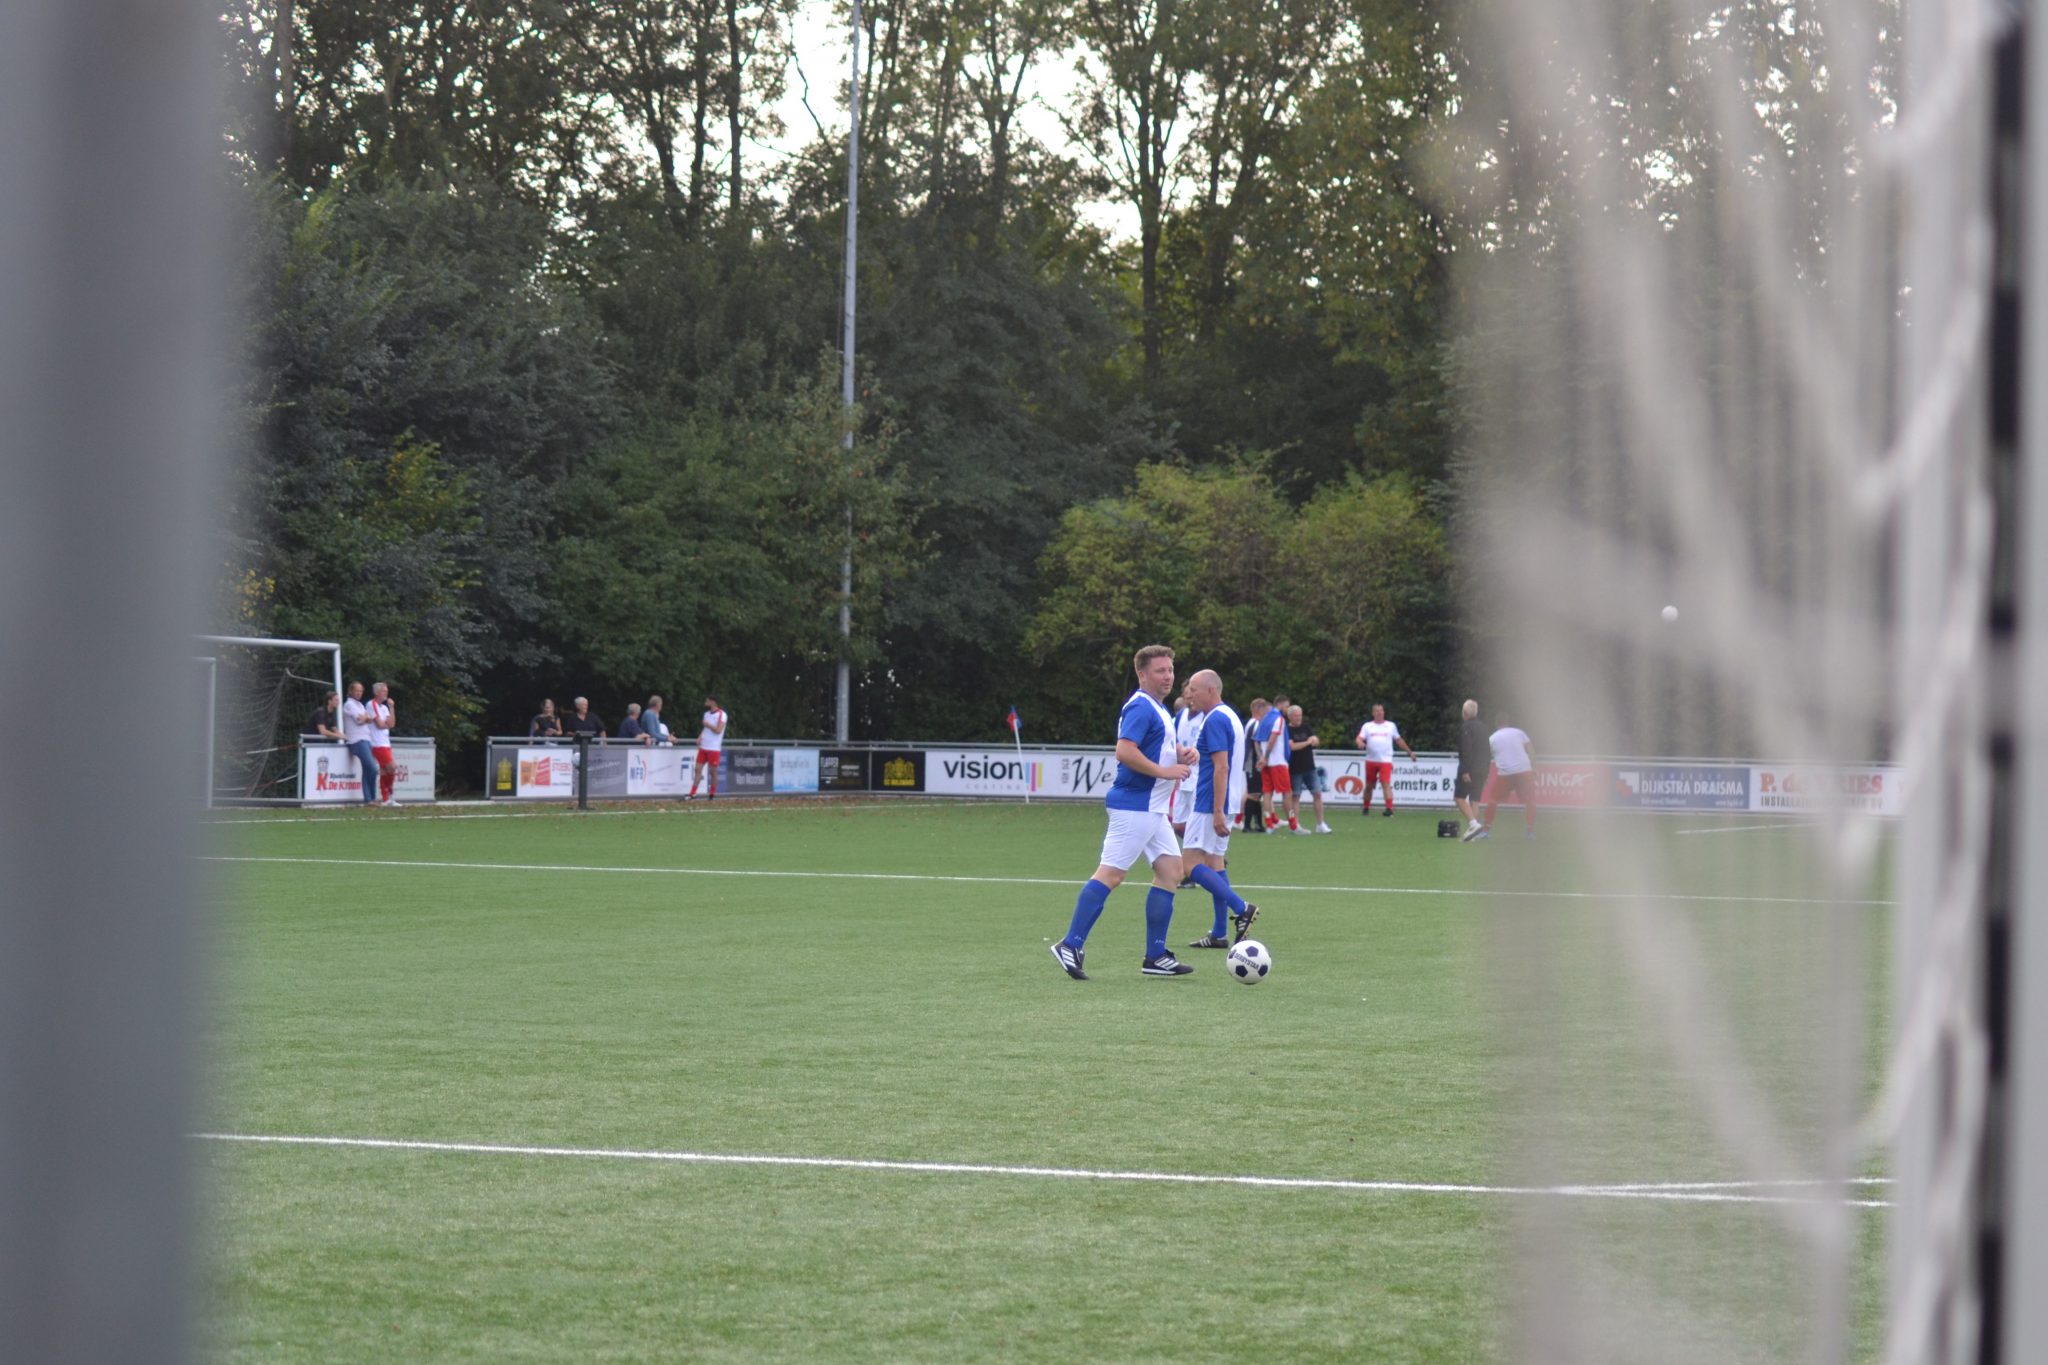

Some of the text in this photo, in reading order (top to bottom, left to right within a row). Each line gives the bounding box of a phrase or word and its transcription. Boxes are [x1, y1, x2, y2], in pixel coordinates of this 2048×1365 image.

[944, 755, 1023, 780] vision
[1392, 765, 1442, 775] etaalhandel
[1391, 778, 1437, 791] emstra
[1641, 781, 1743, 795] DIJKSTRA DRAISMA
